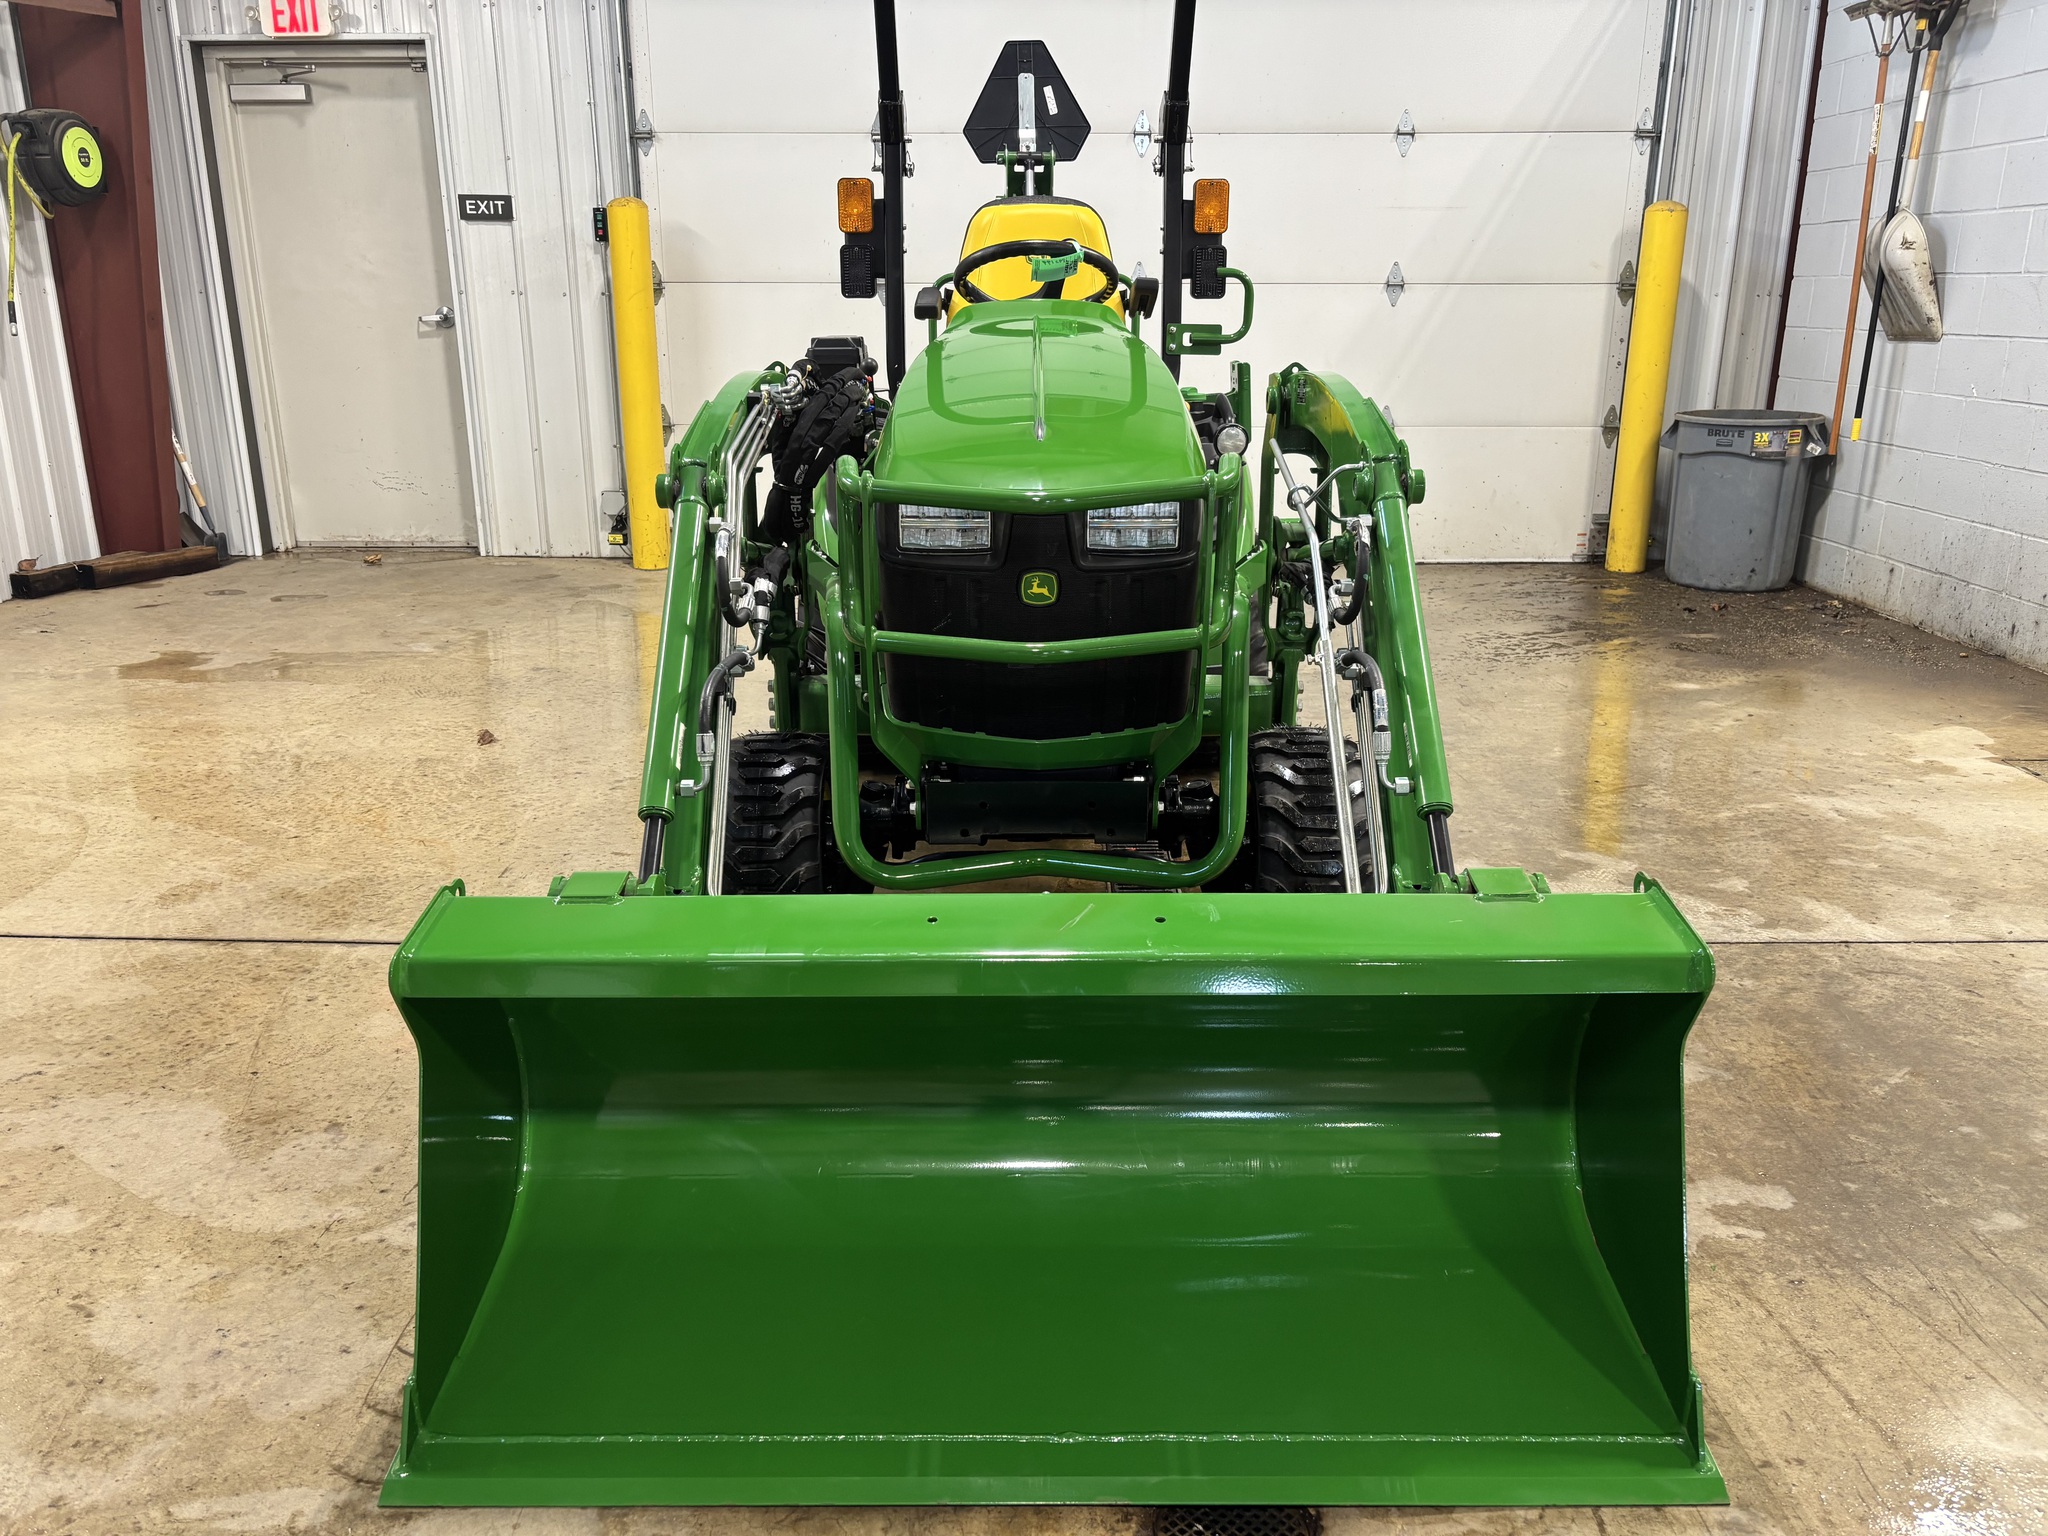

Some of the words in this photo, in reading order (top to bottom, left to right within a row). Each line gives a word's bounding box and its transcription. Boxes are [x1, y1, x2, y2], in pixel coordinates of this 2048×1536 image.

[270, 0, 319, 33] EXIT
[465, 200, 505, 215] EXIT
[1707, 428, 1745, 438] BRUTE
[1754, 432, 1770, 443] 3X
